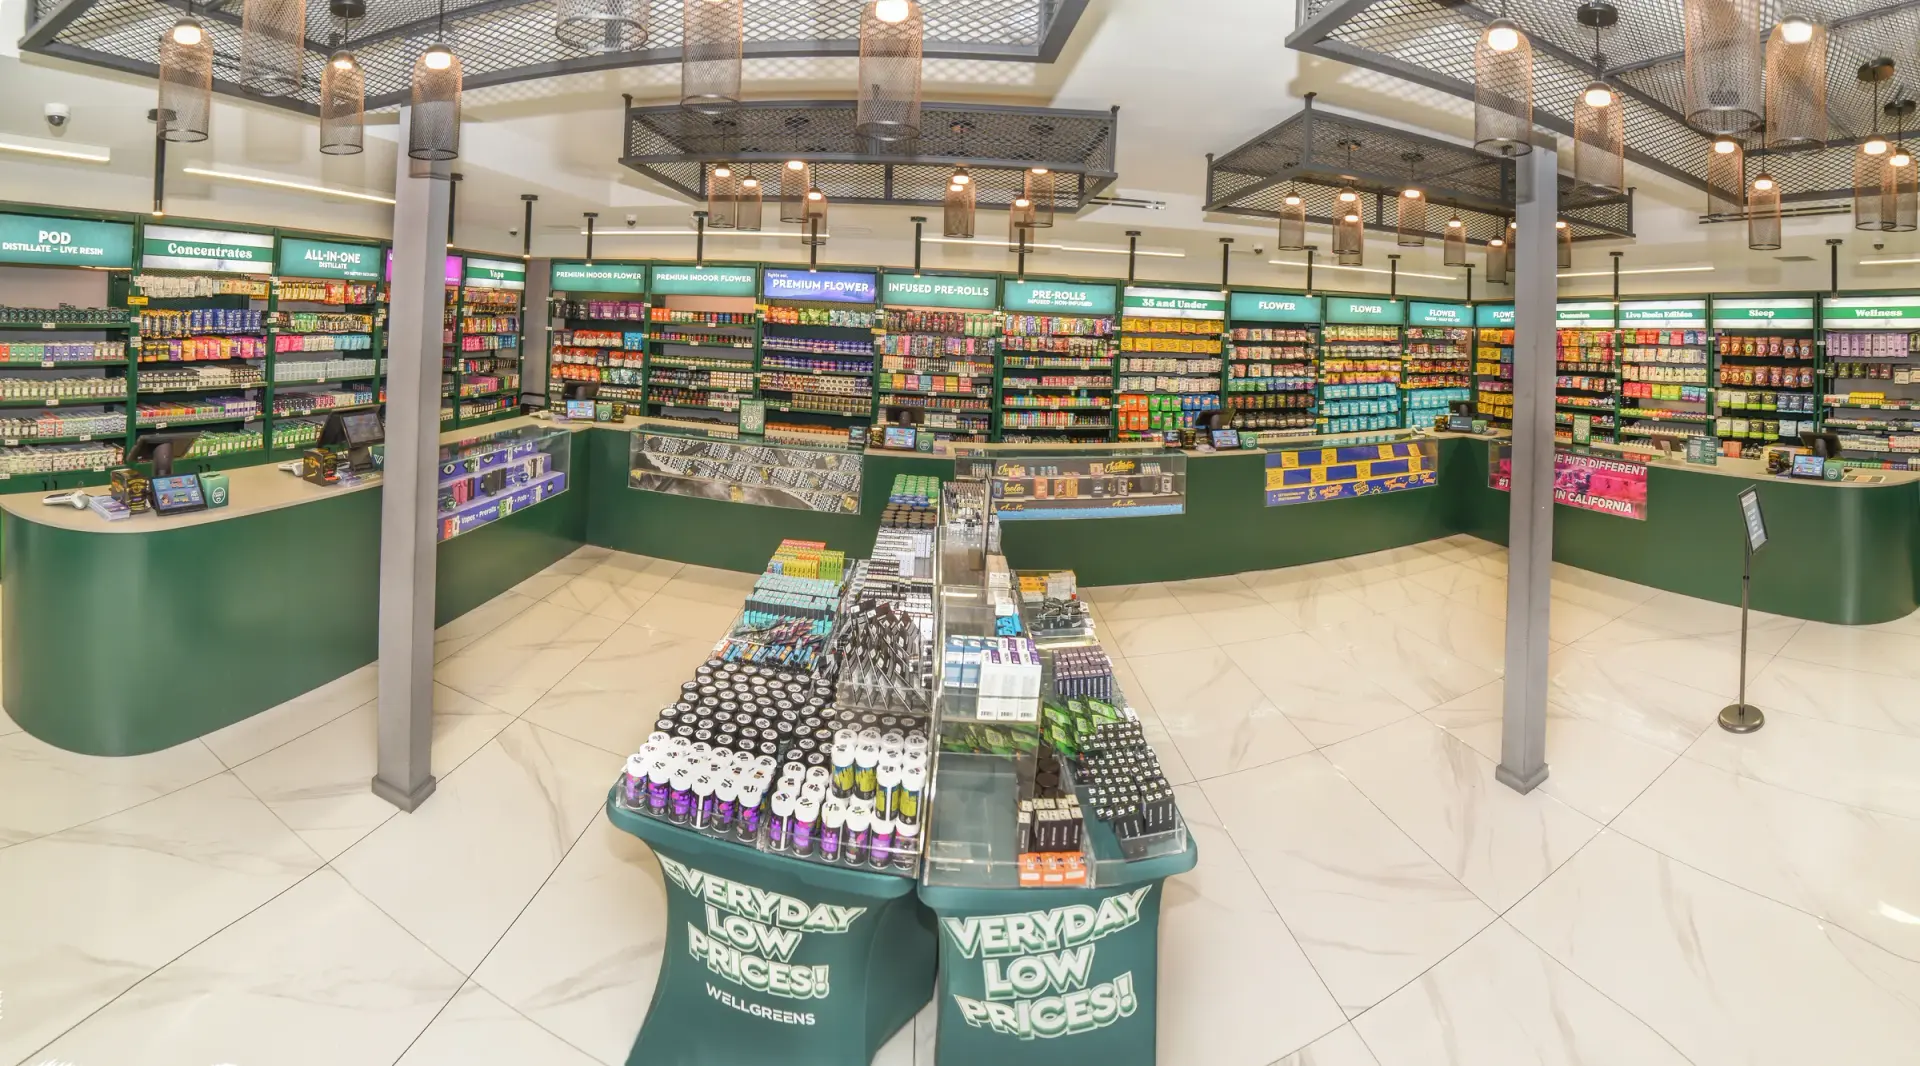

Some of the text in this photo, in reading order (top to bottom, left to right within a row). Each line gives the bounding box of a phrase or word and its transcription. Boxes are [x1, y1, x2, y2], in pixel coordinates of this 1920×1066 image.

[38, 230, 71, 245] POD
[2, 241, 104, 256] DISTILLATE LIVE RESIN
[167, 242, 253, 259] Concentrates
[304, 248, 361, 264] ALL-IN-ONE
[318, 261, 348, 270] DISTILLATE
[489, 269, 505, 279] Vape
[556, 271, 642, 281] PREMIUM INDOOR FLOWER
[656, 273, 752, 284] PREMIUM INDOOR FLOWER
[772, 279, 869, 292] PREMIUM FLOWER
[888, 283, 989, 296] INFUSED PRE-ROLLS
[1032, 289, 1087, 301] PRE-ROLLS
[1142, 298, 1208, 309] 35 and Under
[1258, 301, 1296, 311] FLOWER
[1349, 304, 1382, 314] FLOWER
[1429, 309, 1457, 318] FLOWER
[1664, 311, 1693, 319] Edibles
[1748, 308, 1775, 319] Sleep
[1855, 308, 1903, 318] Wellness
[1565, 455, 1588, 467] HITS
[1588, 458, 1648, 476] DIFFERENT
[1498, 478, 1633, 514] #1 IN CALIFORNIA
[653, 848, 868, 934] EVERYDAY
[940, 884, 1153, 959] VERYDAY
[704, 903, 803, 963] LOW
[687, 921, 830, 1000] PRICES!
[982, 942, 1096, 1001] LOW
[706, 982, 816, 1026] WELLGREENS
[953, 970, 1138, 1041] PRICES!
